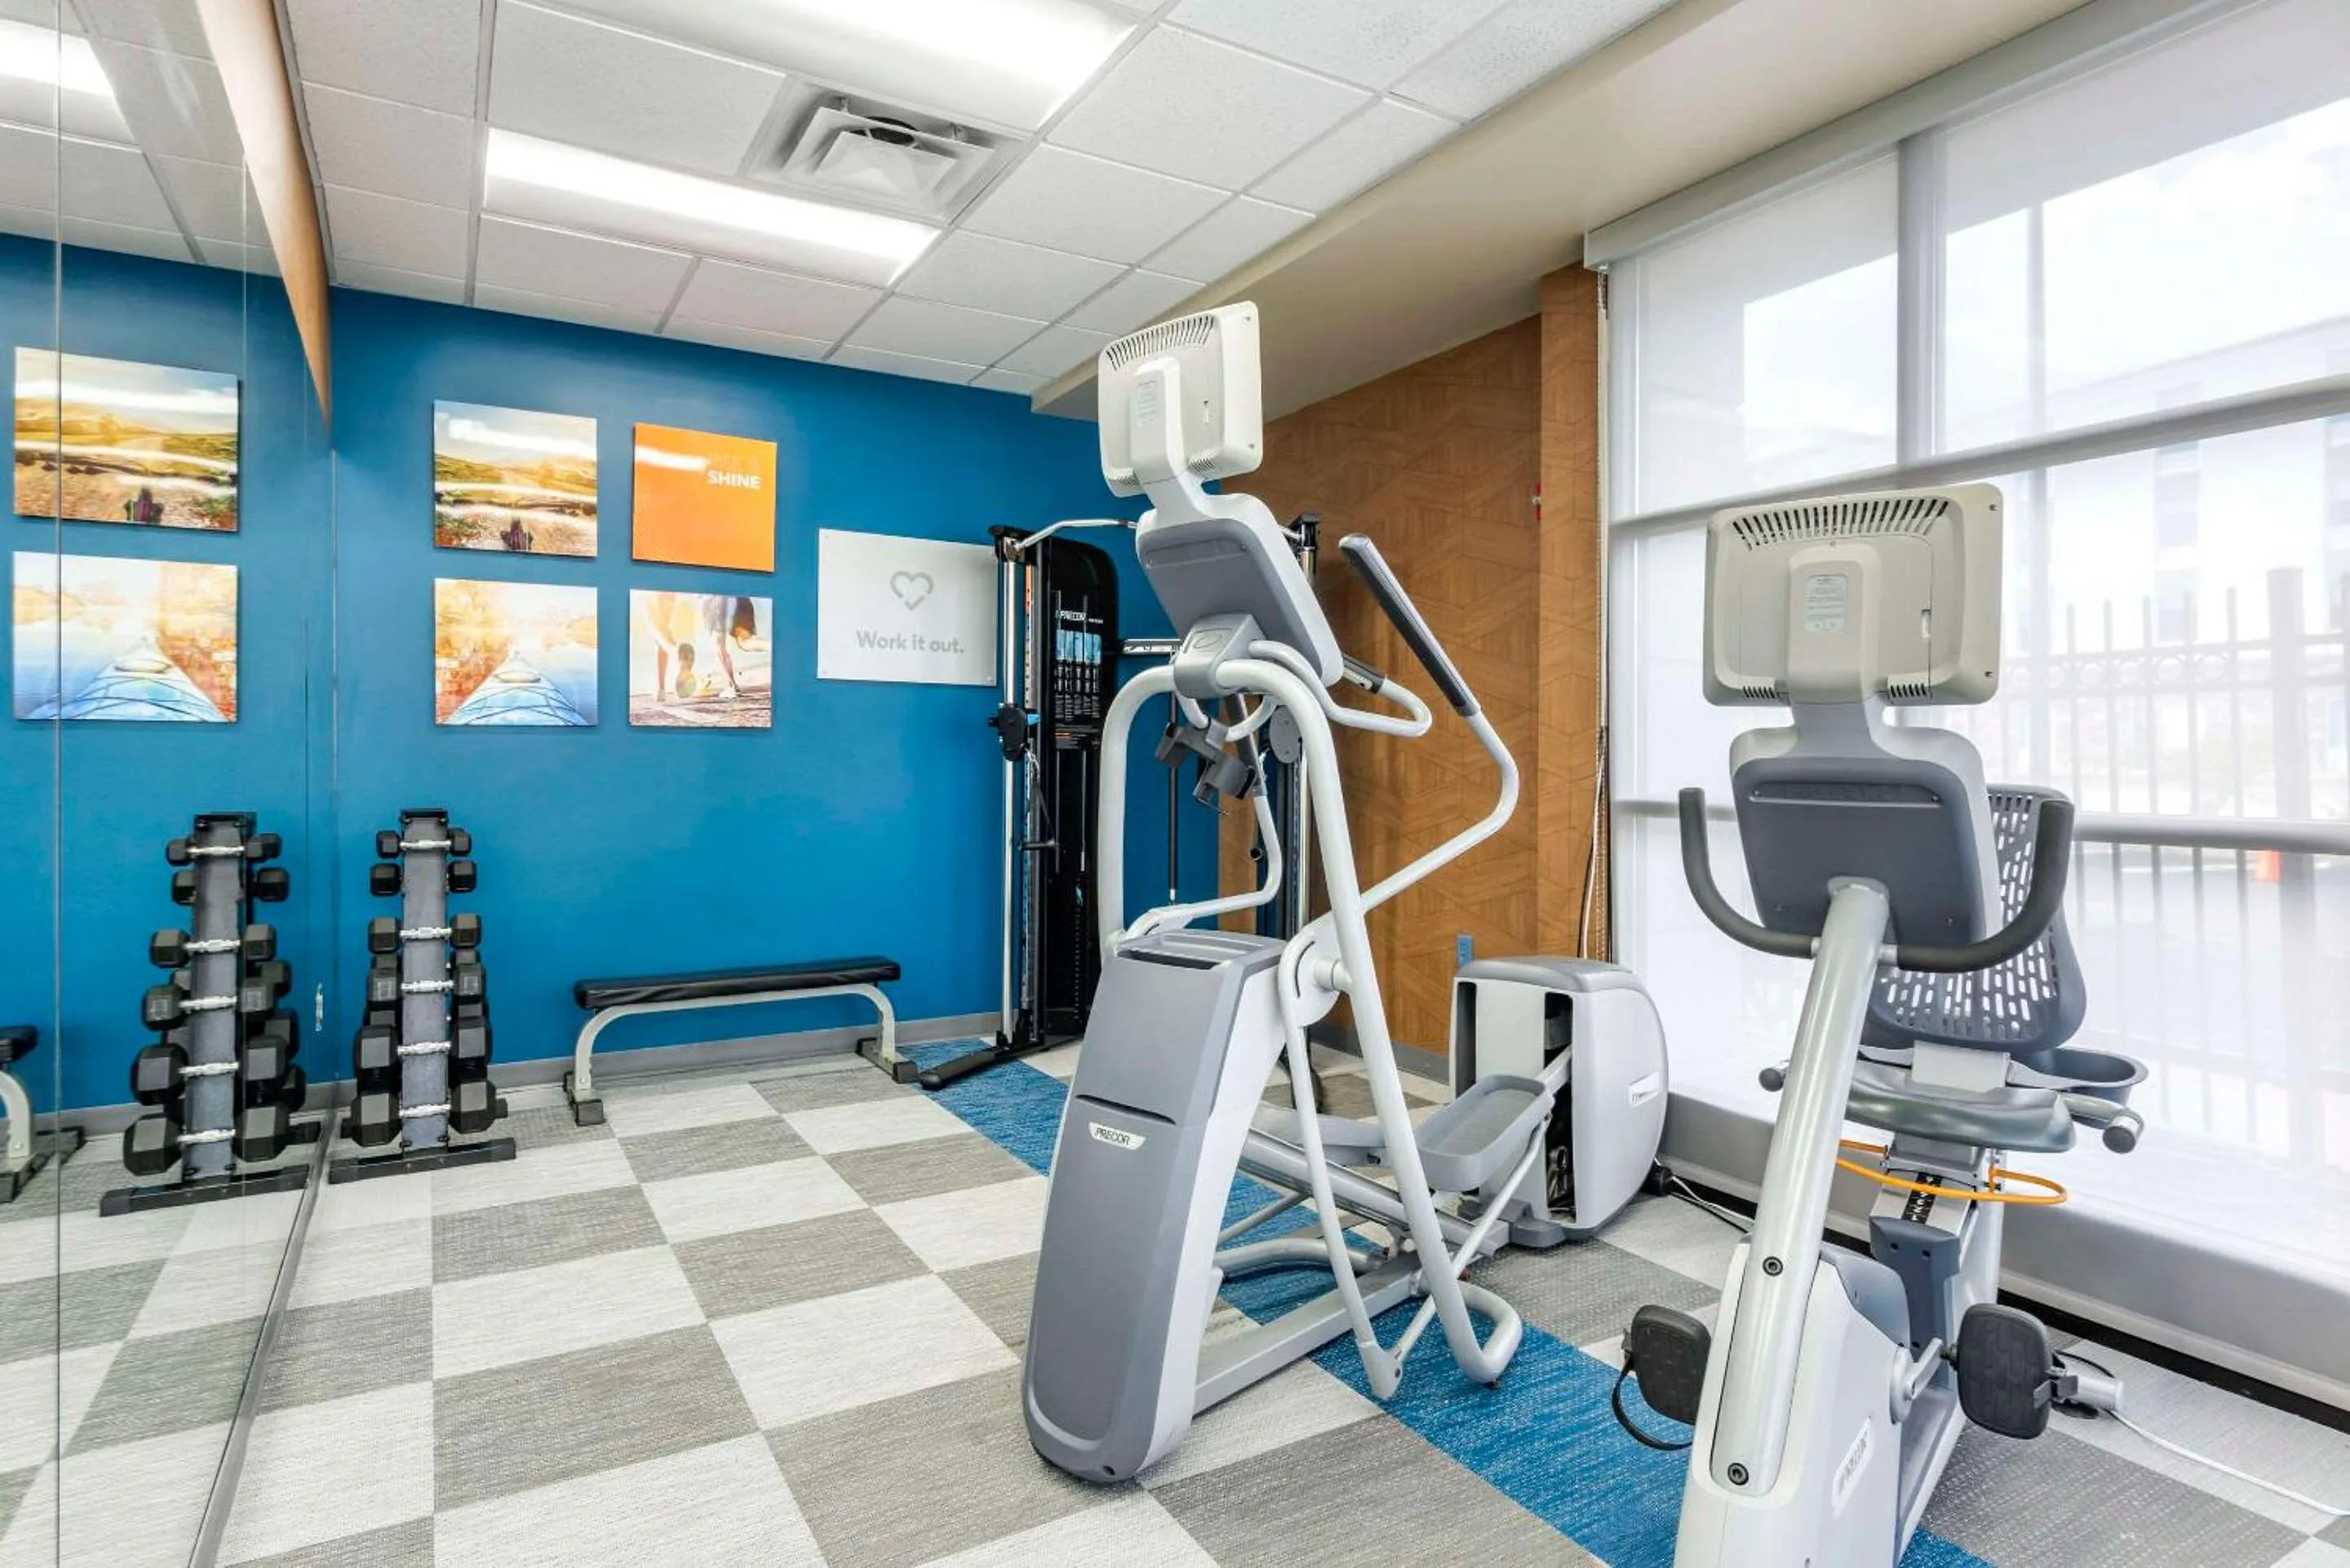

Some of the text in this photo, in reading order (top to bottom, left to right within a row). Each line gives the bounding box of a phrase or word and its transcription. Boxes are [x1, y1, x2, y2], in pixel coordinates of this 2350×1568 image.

[707, 470, 761, 489] SHINE
[856, 629, 964, 653] Work it out.
[1095, 1127, 1130, 1145] PRECOR
